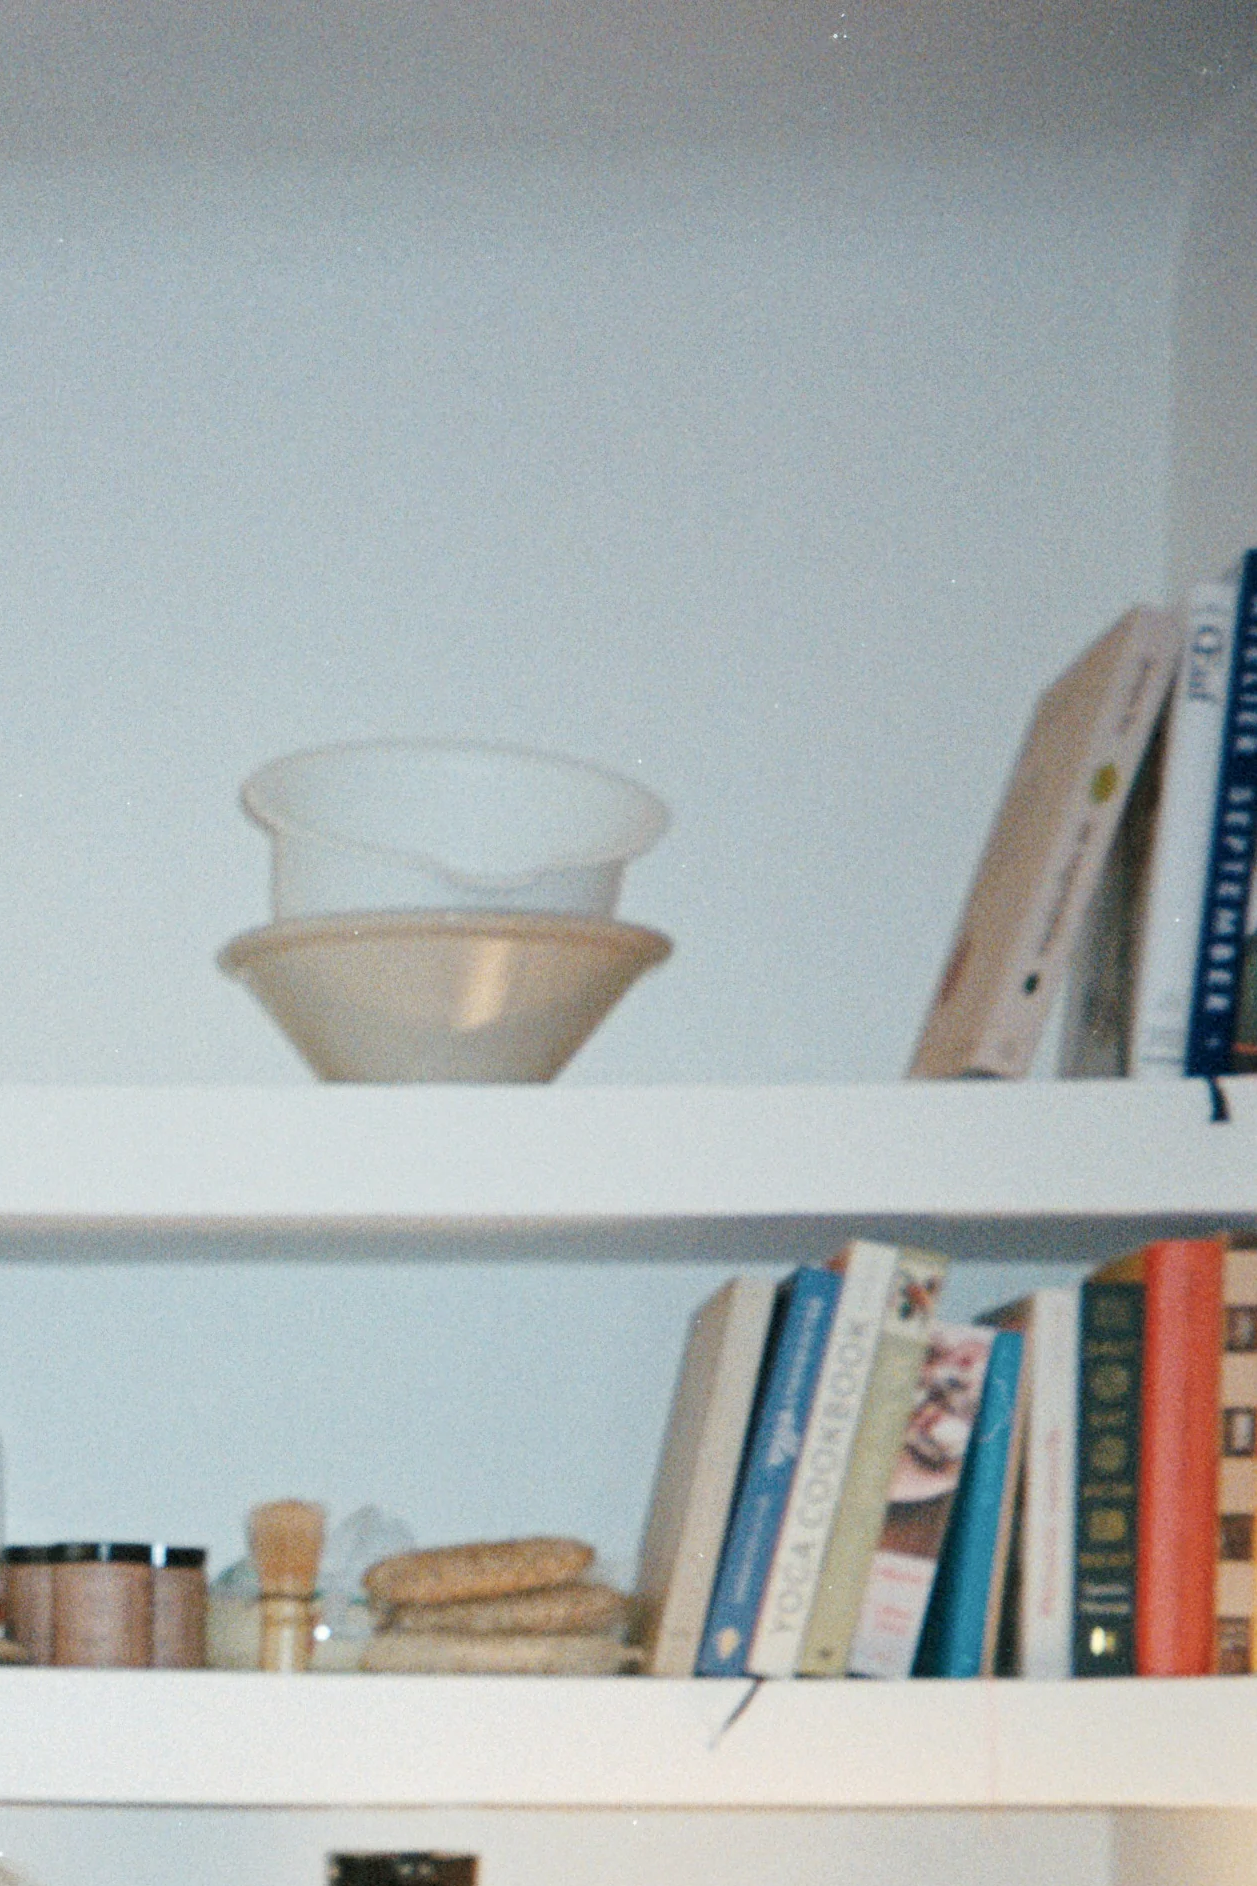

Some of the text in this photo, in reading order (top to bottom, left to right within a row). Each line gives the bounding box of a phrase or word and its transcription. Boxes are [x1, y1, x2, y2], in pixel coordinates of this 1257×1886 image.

[1204, 786, 1253, 1013] SEPTEMBER
[771, 1540, 814, 1635] YOGA
[795, 1316, 869, 1531] COOKBOOK
